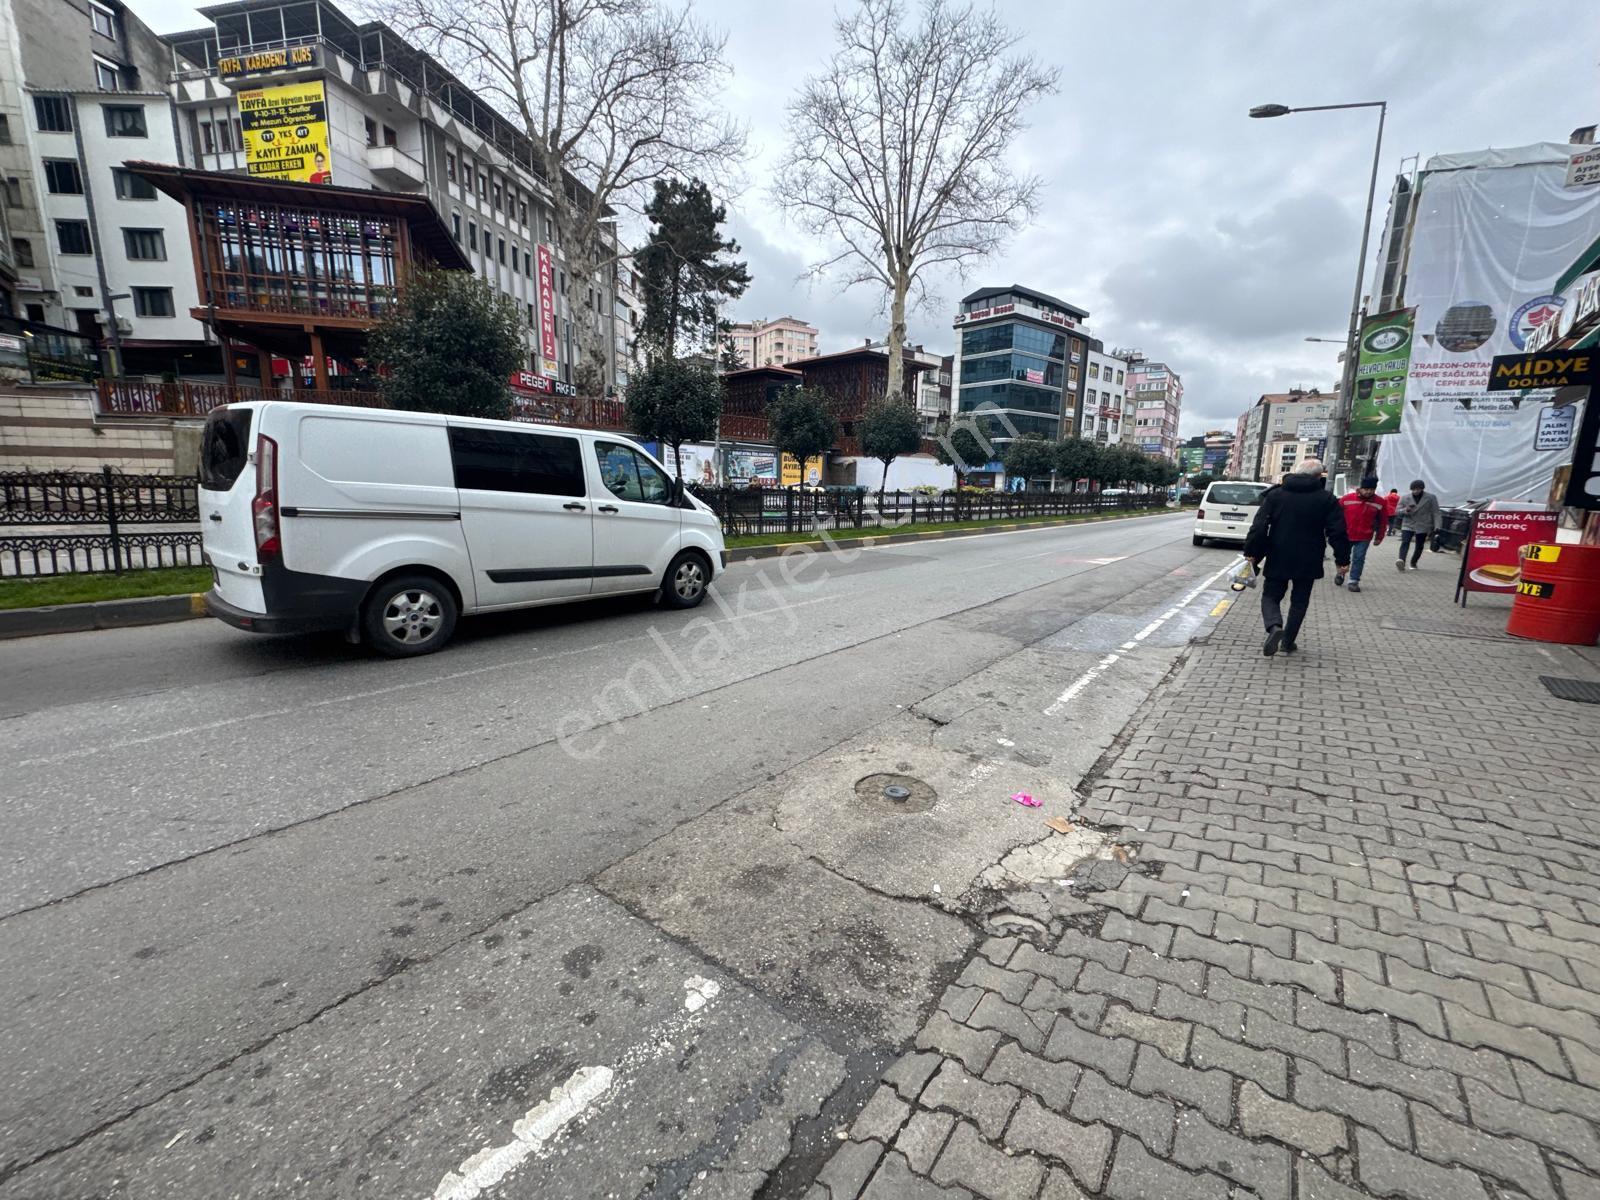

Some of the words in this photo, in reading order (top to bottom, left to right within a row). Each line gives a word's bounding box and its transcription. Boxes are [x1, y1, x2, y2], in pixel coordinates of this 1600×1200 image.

[219, 58, 242, 74] TAYFA
[291, 47, 313, 64] KURS
[241, 98, 267, 110] TAYFA
[260, 117, 282, 127] Mezun
[262, 131, 275, 140] TYT
[278, 129, 293, 139] YKS
[297, 127, 309, 137] AYT
[256, 147, 282, 160] KAYIT
[285, 143, 320, 157] ZAMANI
[249, 163, 259, 173] NE
[260, 161, 281, 172] KADAR
[1496, 356, 1590, 378] MİDYE
[520, 372, 550, 392] PEGEM
[1508, 376, 1569, 388] DOLMA
[1478, 513, 1521, 521] Ekmek
[1477, 522, 1528, 532] Kokoreç
